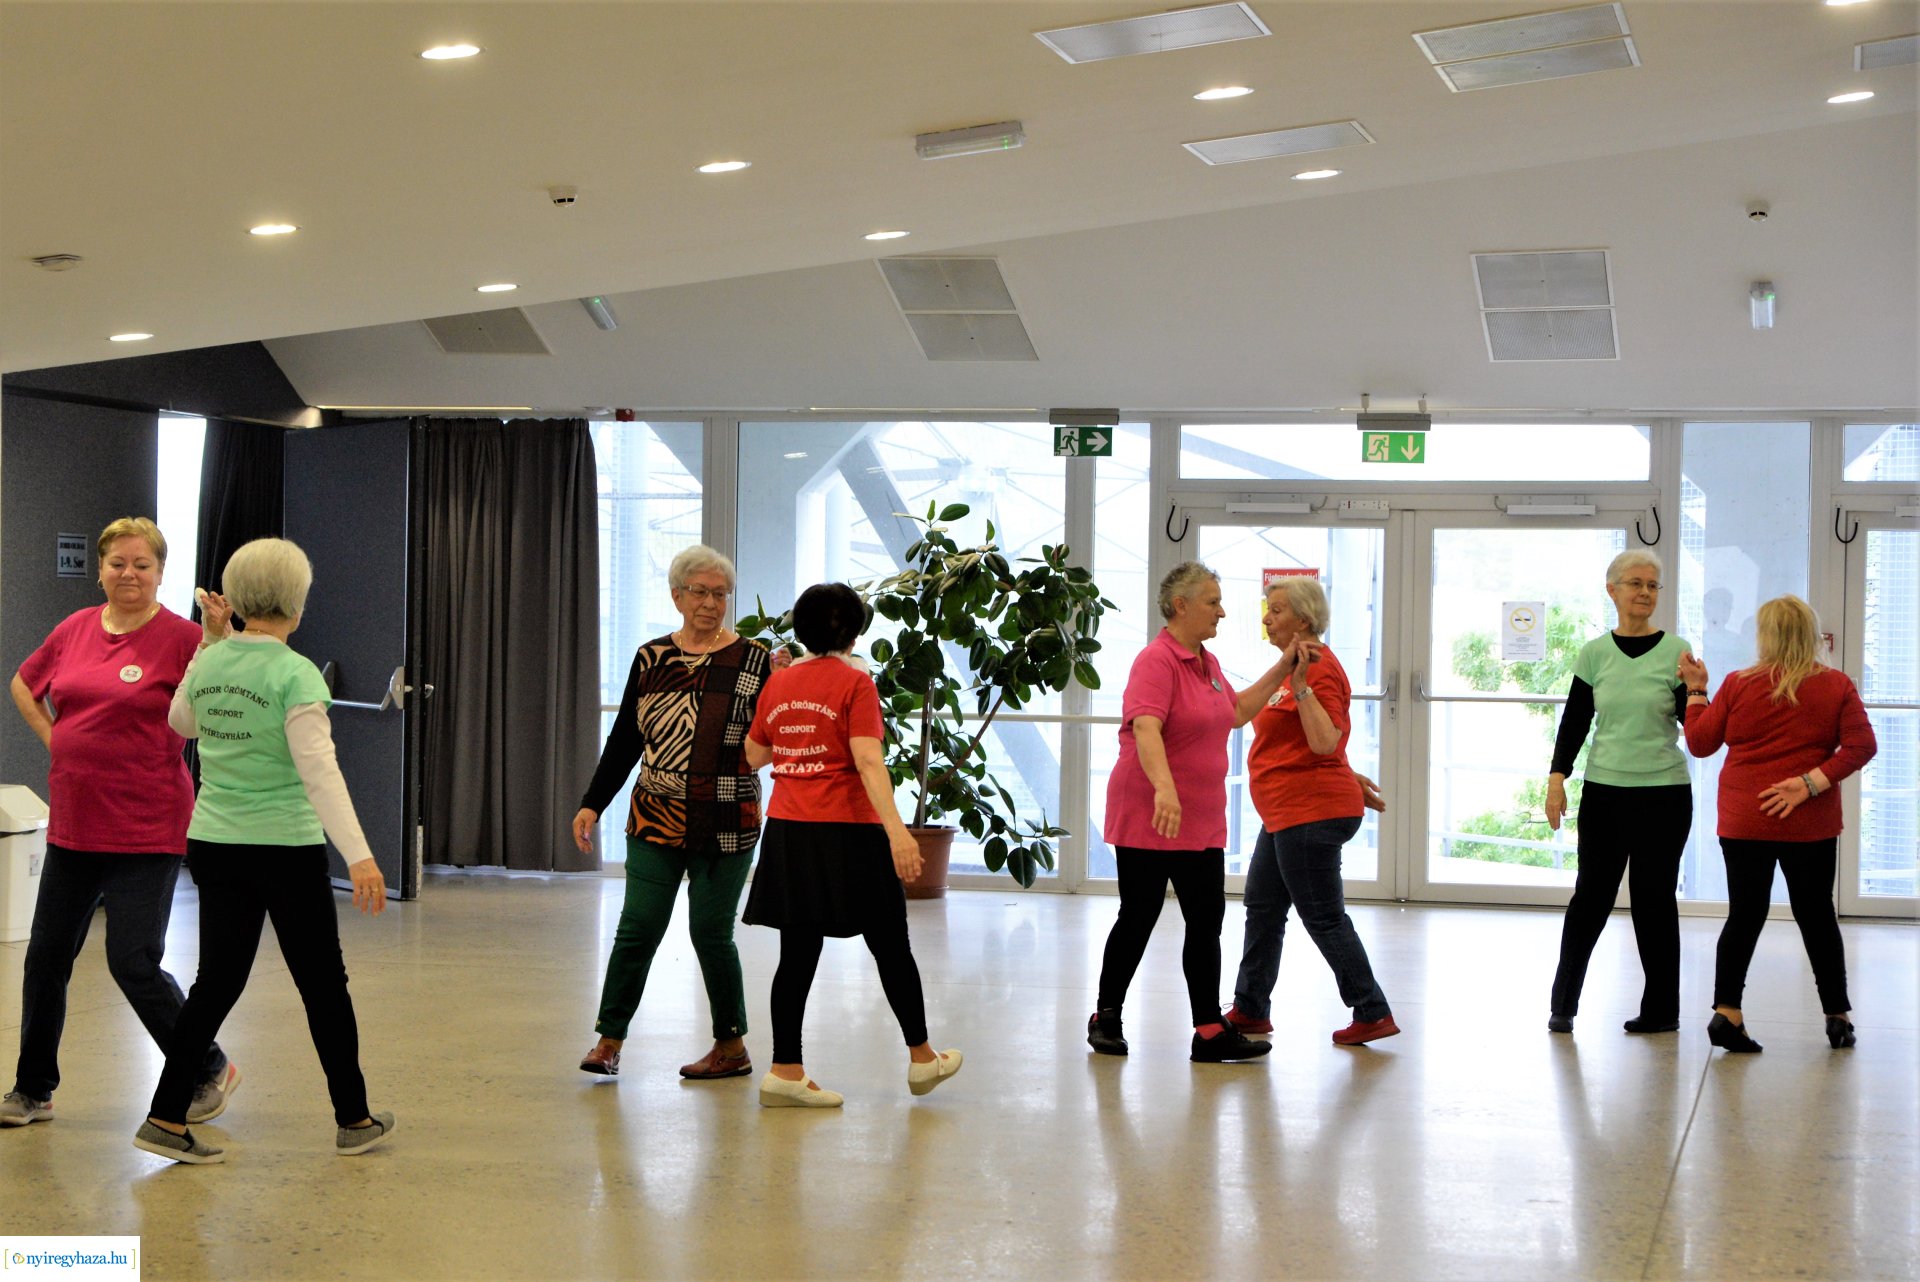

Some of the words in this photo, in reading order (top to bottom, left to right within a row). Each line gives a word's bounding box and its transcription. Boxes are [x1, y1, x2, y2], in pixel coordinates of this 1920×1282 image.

[224, 685, 269, 708] ÖRÖMTÁNC
[207, 708, 244, 718] CSOPORT
[779, 725, 816, 734] CSOPORT
[774, 761, 825, 774] OKTATÓ
